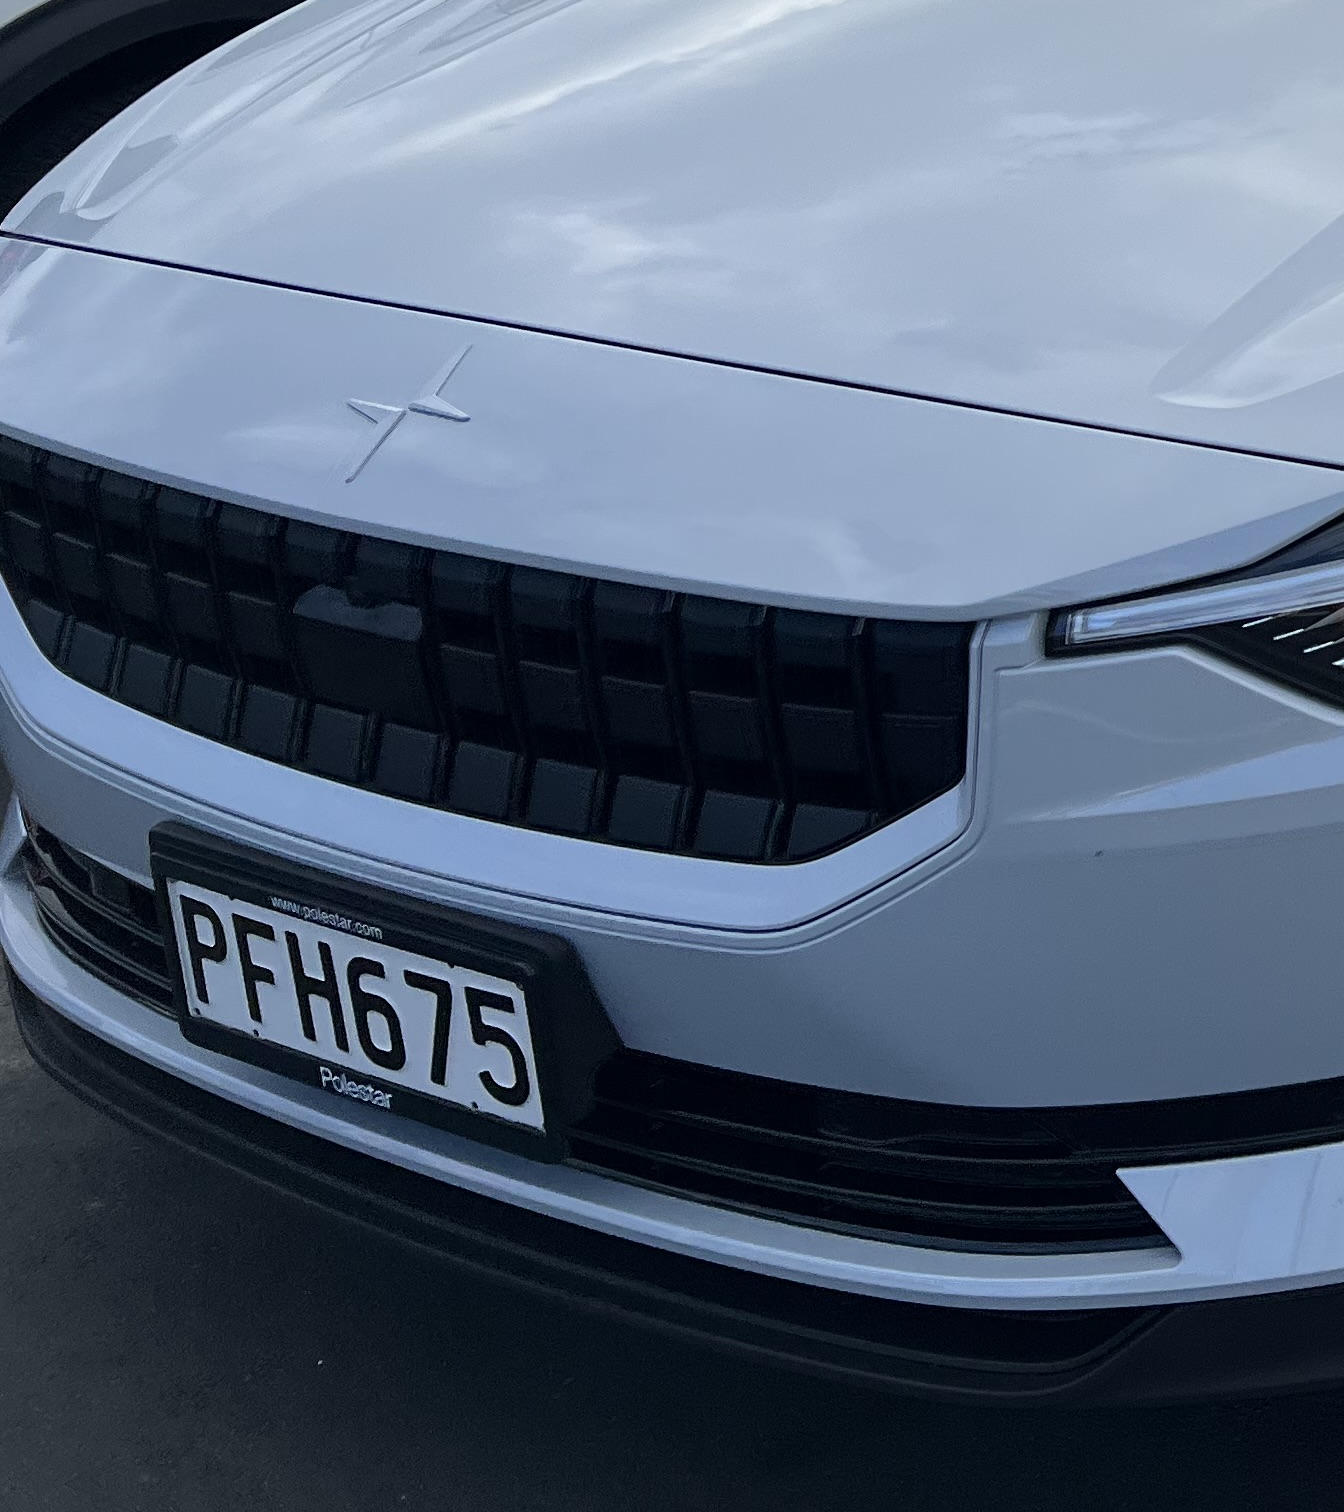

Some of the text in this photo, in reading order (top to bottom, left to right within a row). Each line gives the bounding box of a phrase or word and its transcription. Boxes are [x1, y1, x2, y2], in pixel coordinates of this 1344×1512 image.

[271, 895, 383, 940] www.polestar.com
[179, 894, 530, 1106] PFH675
[319, 1066, 393, 1109] Polestar
